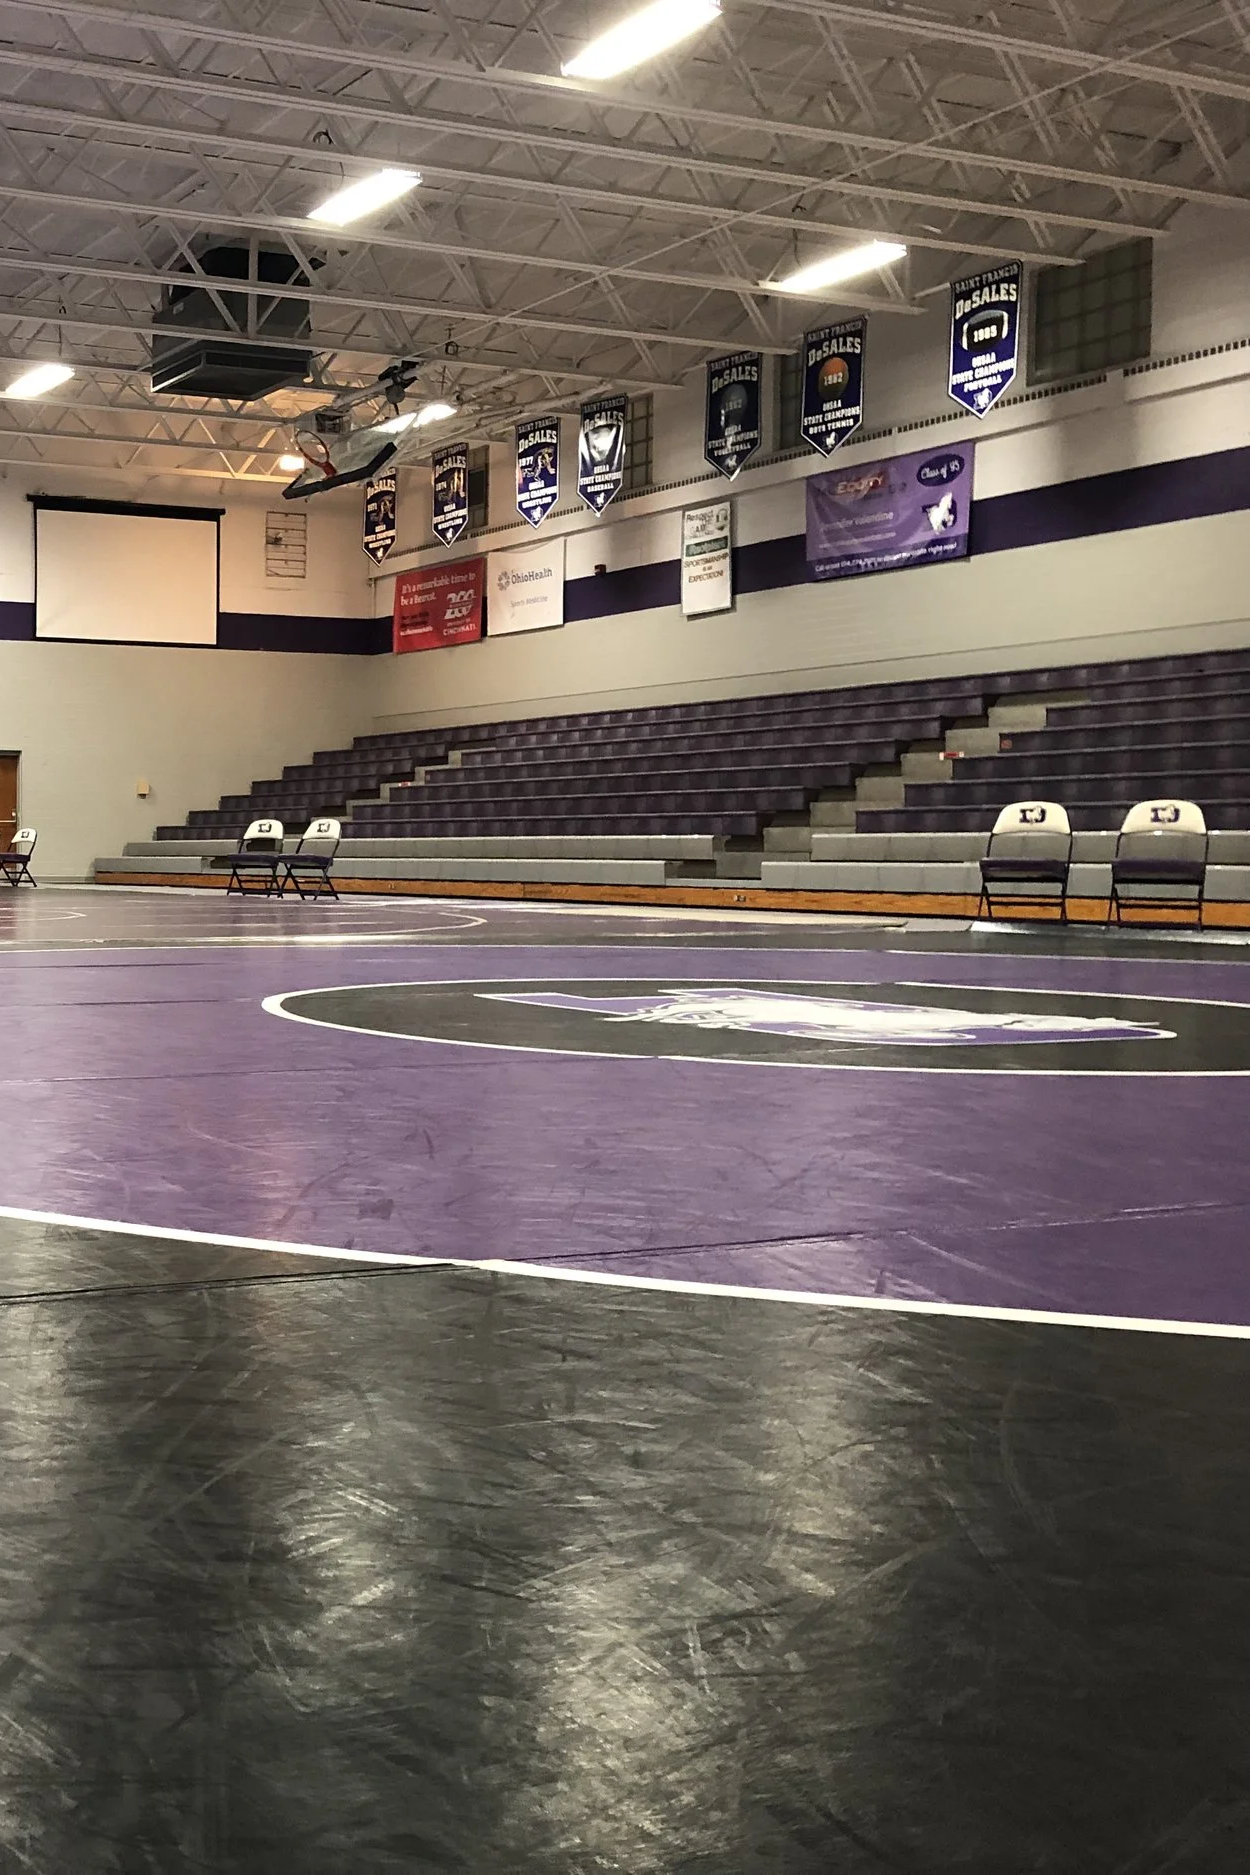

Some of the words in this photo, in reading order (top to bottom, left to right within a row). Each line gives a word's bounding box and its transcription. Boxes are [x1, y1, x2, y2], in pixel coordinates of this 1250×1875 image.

[955, 276, 981, 293] SAINT
[982, 263, 1019, 285] FRANCIS
[955, 283, 1018, 320] DeSALES
[807, 328, 831, 343] SAINT
[832, 320, 862, 337] FRANCIS
[807, 336, 862, 367] DeSALES
[711, 365, 758, 394] DeSALES
[803, 413, 824, 426] STATE
[824, 405, 861, 422] CHAMPIONS
[827, 418, 854, 430] TENNIS
[518, 429, 558, 453] DeSALES
[451, 573, 468, 584] time
[468, 571, 476, 581] to
[511, 567, 553, 585] OhioHealth
